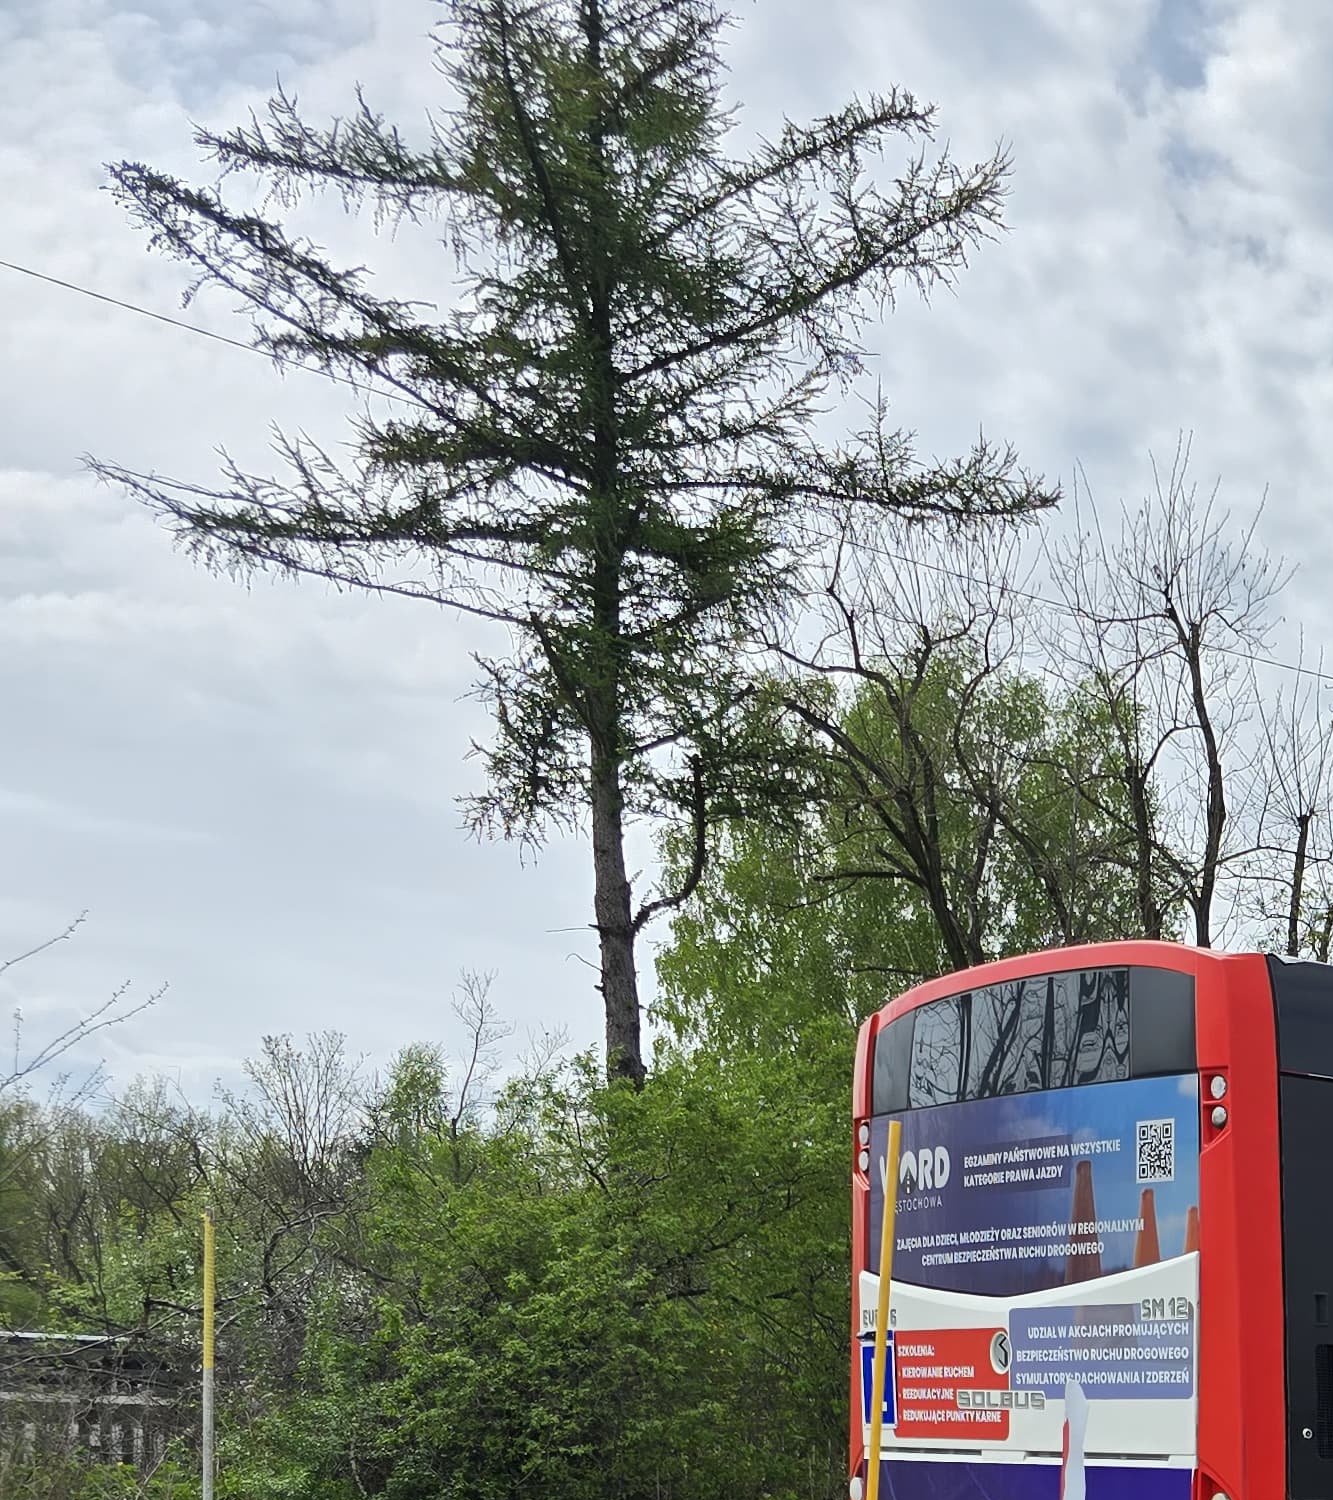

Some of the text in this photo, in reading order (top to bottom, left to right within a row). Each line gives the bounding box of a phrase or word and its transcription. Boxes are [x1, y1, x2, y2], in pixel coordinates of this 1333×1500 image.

[964, 1139, 1121, 1168] EGZAMINY PAŃSTWOWE NA WSZYSTKIE
[964, 1165, 1064, 1188] KATEGORIE PRAWA JAZDY
[894, 1195, 943, 1214] ĘSTOCHOWA
[896, 1218, 1144, 1252] ZAJĘCIA DLA DZIECI, MŁODZIEŻY ORAZ SENIORÓW W REGIONALNYM
[921, 1242, 1105, 1266] CENTRUM BEZPIECZEŃSTWA RUCHU DROGOWEGO
[1141, 1297, 1188, 1319] SM 12
[890, 1308, 897, 1328] 6
[1028, 1322, 1189, 1340] UDZIAŁ W AKCJACH PROMUJĄCYCH
[897, 1345, 935, 1357] SZKOLENIA:
[1016, 1346, 1189, 1362] BEZPIECZEŃSTWO RUCHU DROGOWEGO
[902, 1366, 975, 1378] KIEROWANIE RUCHEM
[1016, 1367, 1189, 1385] SYMULATORY: DACHOWANIA I ZDERZEŃ
[903, 1388, 954, 1400] REEDUKACYJNE
[957, 1391, 1045, 1410] SOLBUS
[903, 1410, 1002, 1424] REDUKUJĄCE PUNKTY KARNE
